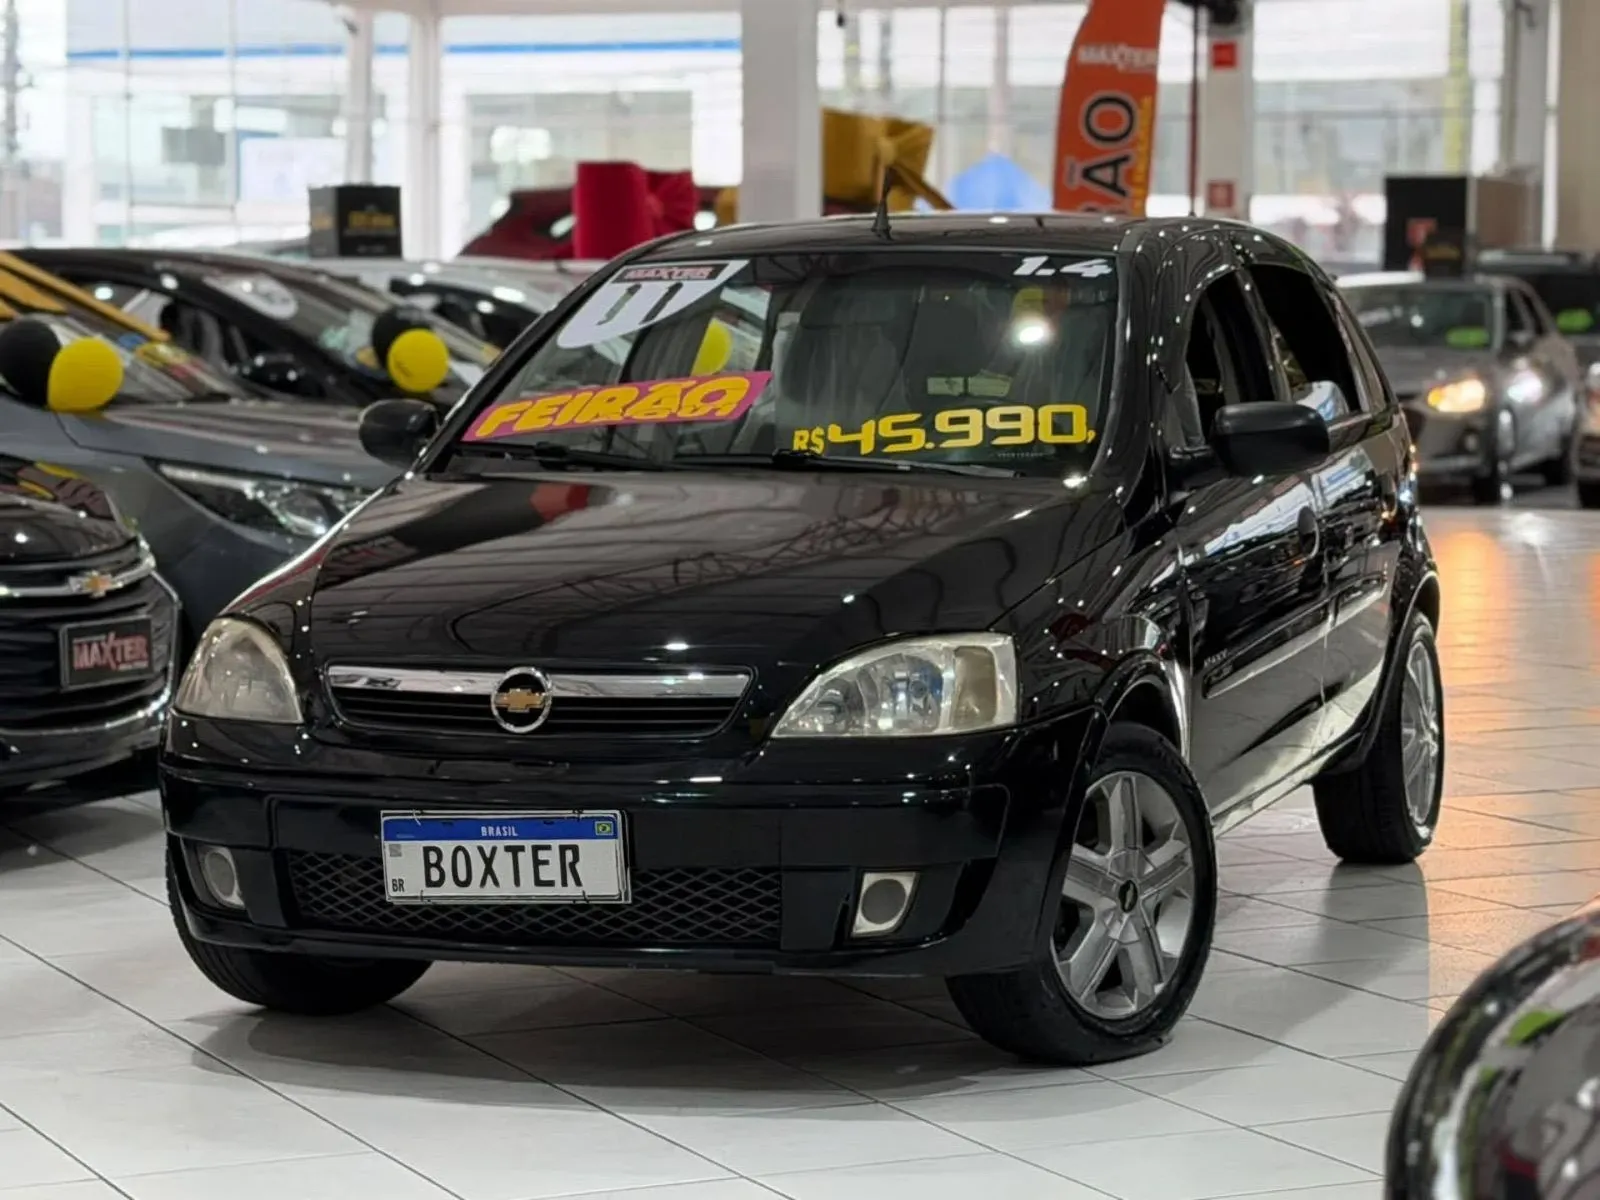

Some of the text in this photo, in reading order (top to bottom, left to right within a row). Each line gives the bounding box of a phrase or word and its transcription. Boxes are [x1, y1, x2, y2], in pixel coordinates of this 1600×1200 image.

[1013, 255, 1113, 278] 1.4
[475, 376, 751, 438] FEIRÃO
[72, 631, 149, 671] MAXTER
[480, 825, 519, 837] BRASIL
[422, 844, 583, 889] BOXTER
[391, 878, 405, 892] BR
